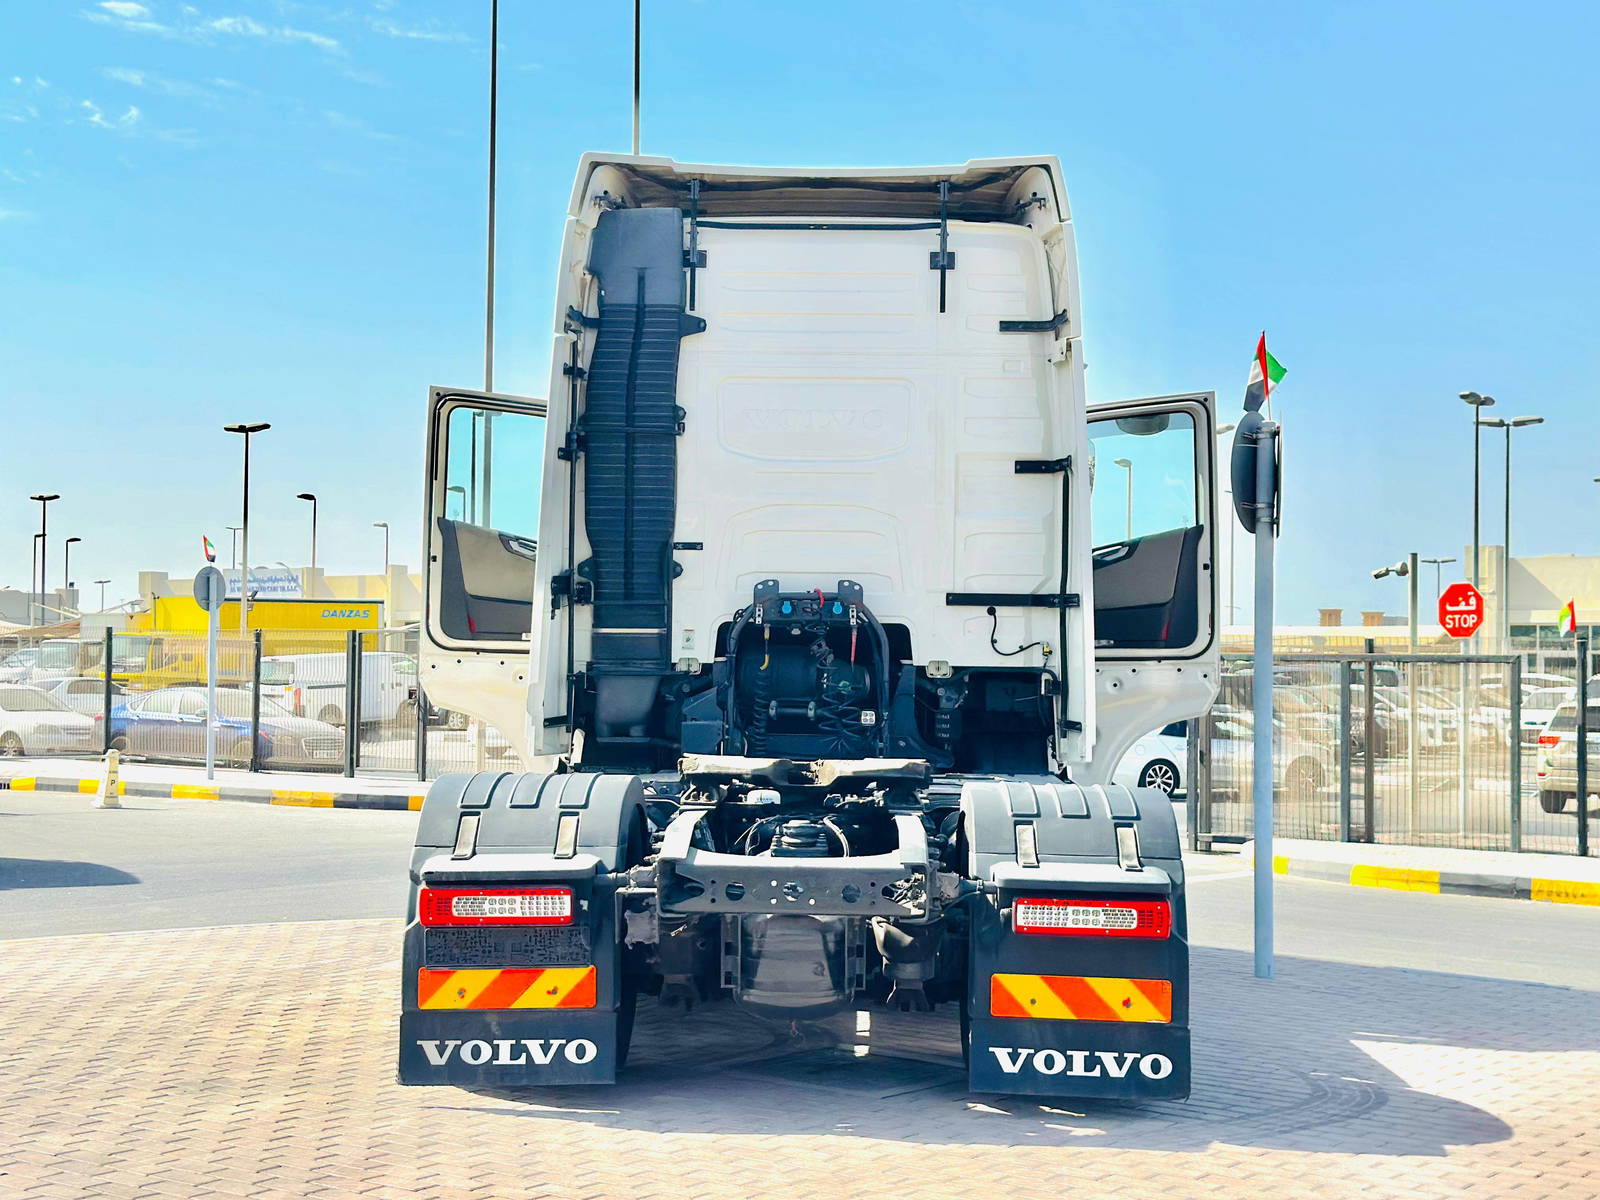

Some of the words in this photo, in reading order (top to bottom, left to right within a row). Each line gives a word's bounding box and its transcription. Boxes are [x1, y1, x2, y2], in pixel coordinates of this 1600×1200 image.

[1446, 591, 1476, 611] قف
[321, 609, 369, 618] DANZAS
[1445, 614, 1477, 628] STOP
[418, 1039, 598, 1066] VOLVO
[988, 1047, 1173, 1080] VOLVO
